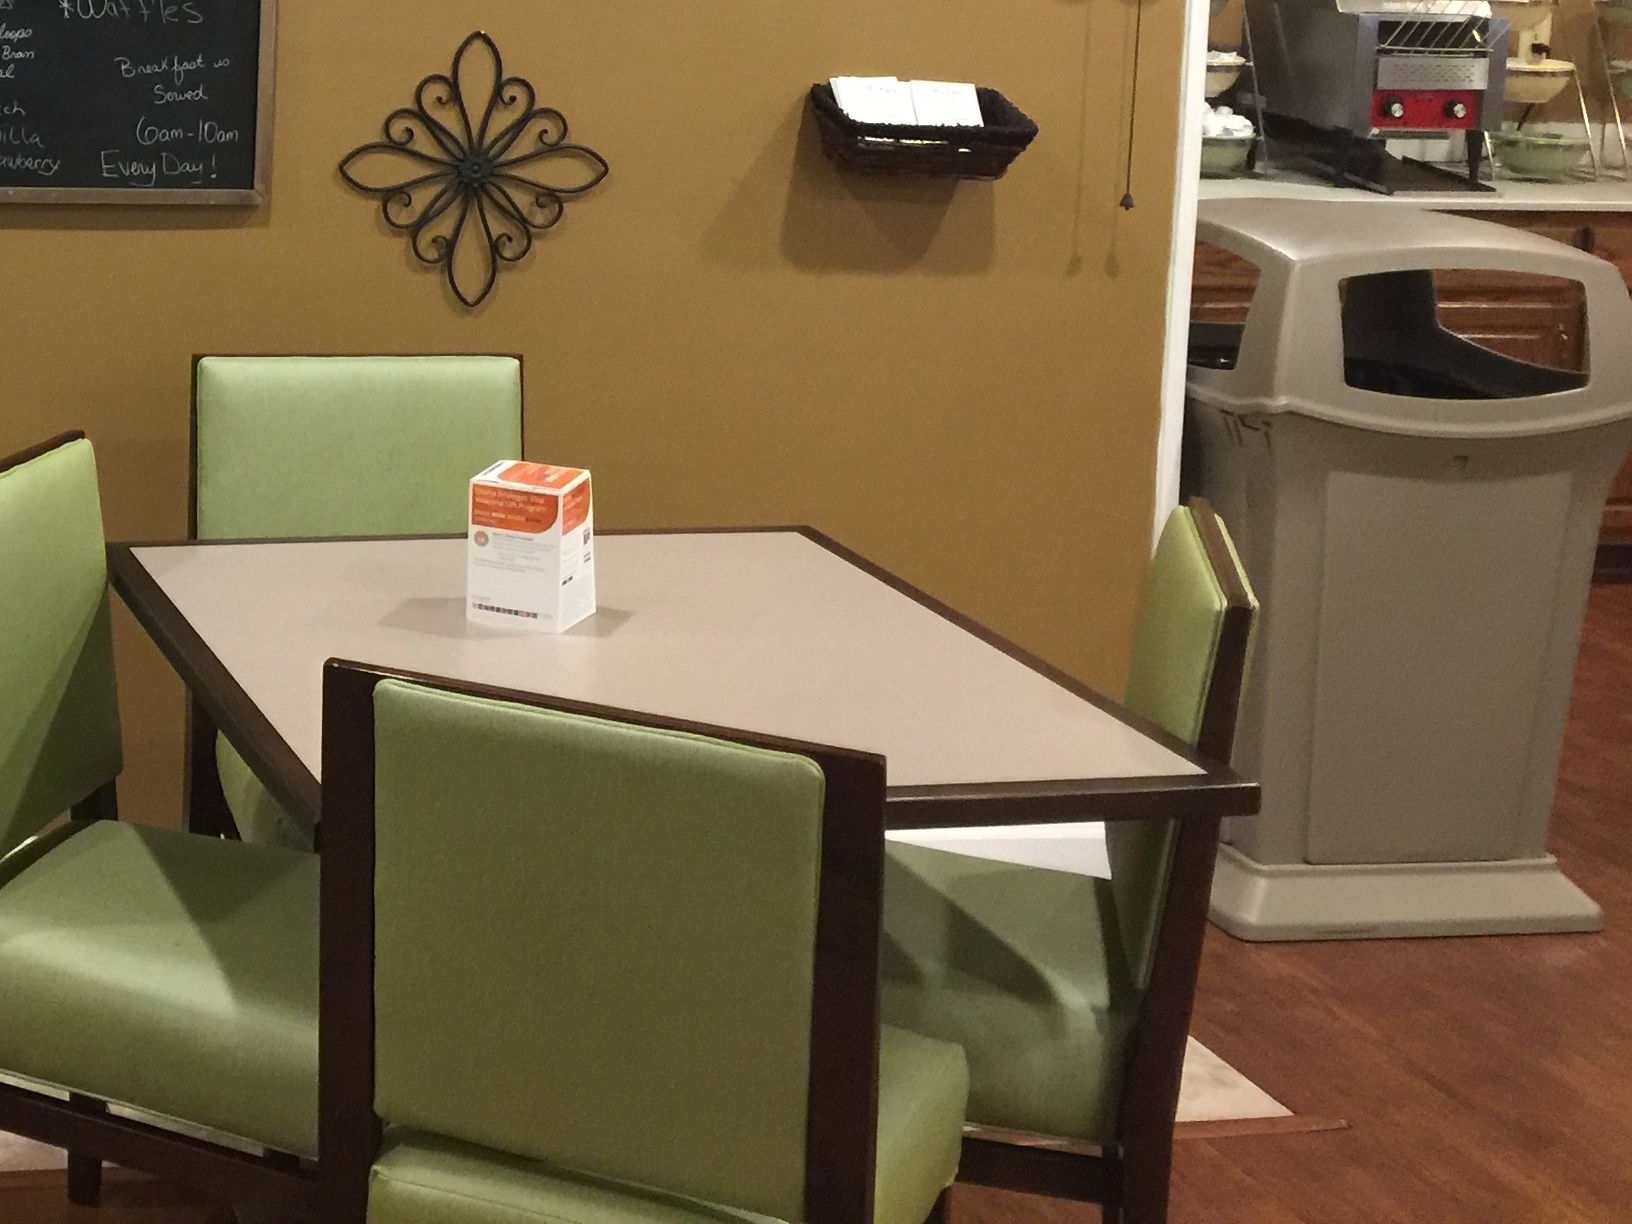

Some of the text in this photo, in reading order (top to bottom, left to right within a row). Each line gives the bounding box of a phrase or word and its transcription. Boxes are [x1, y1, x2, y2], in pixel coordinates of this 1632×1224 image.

[1, 44, 35, 61] Bran
[153, 83, 209, 105] Served
[100, 149, 156, 187] Every
